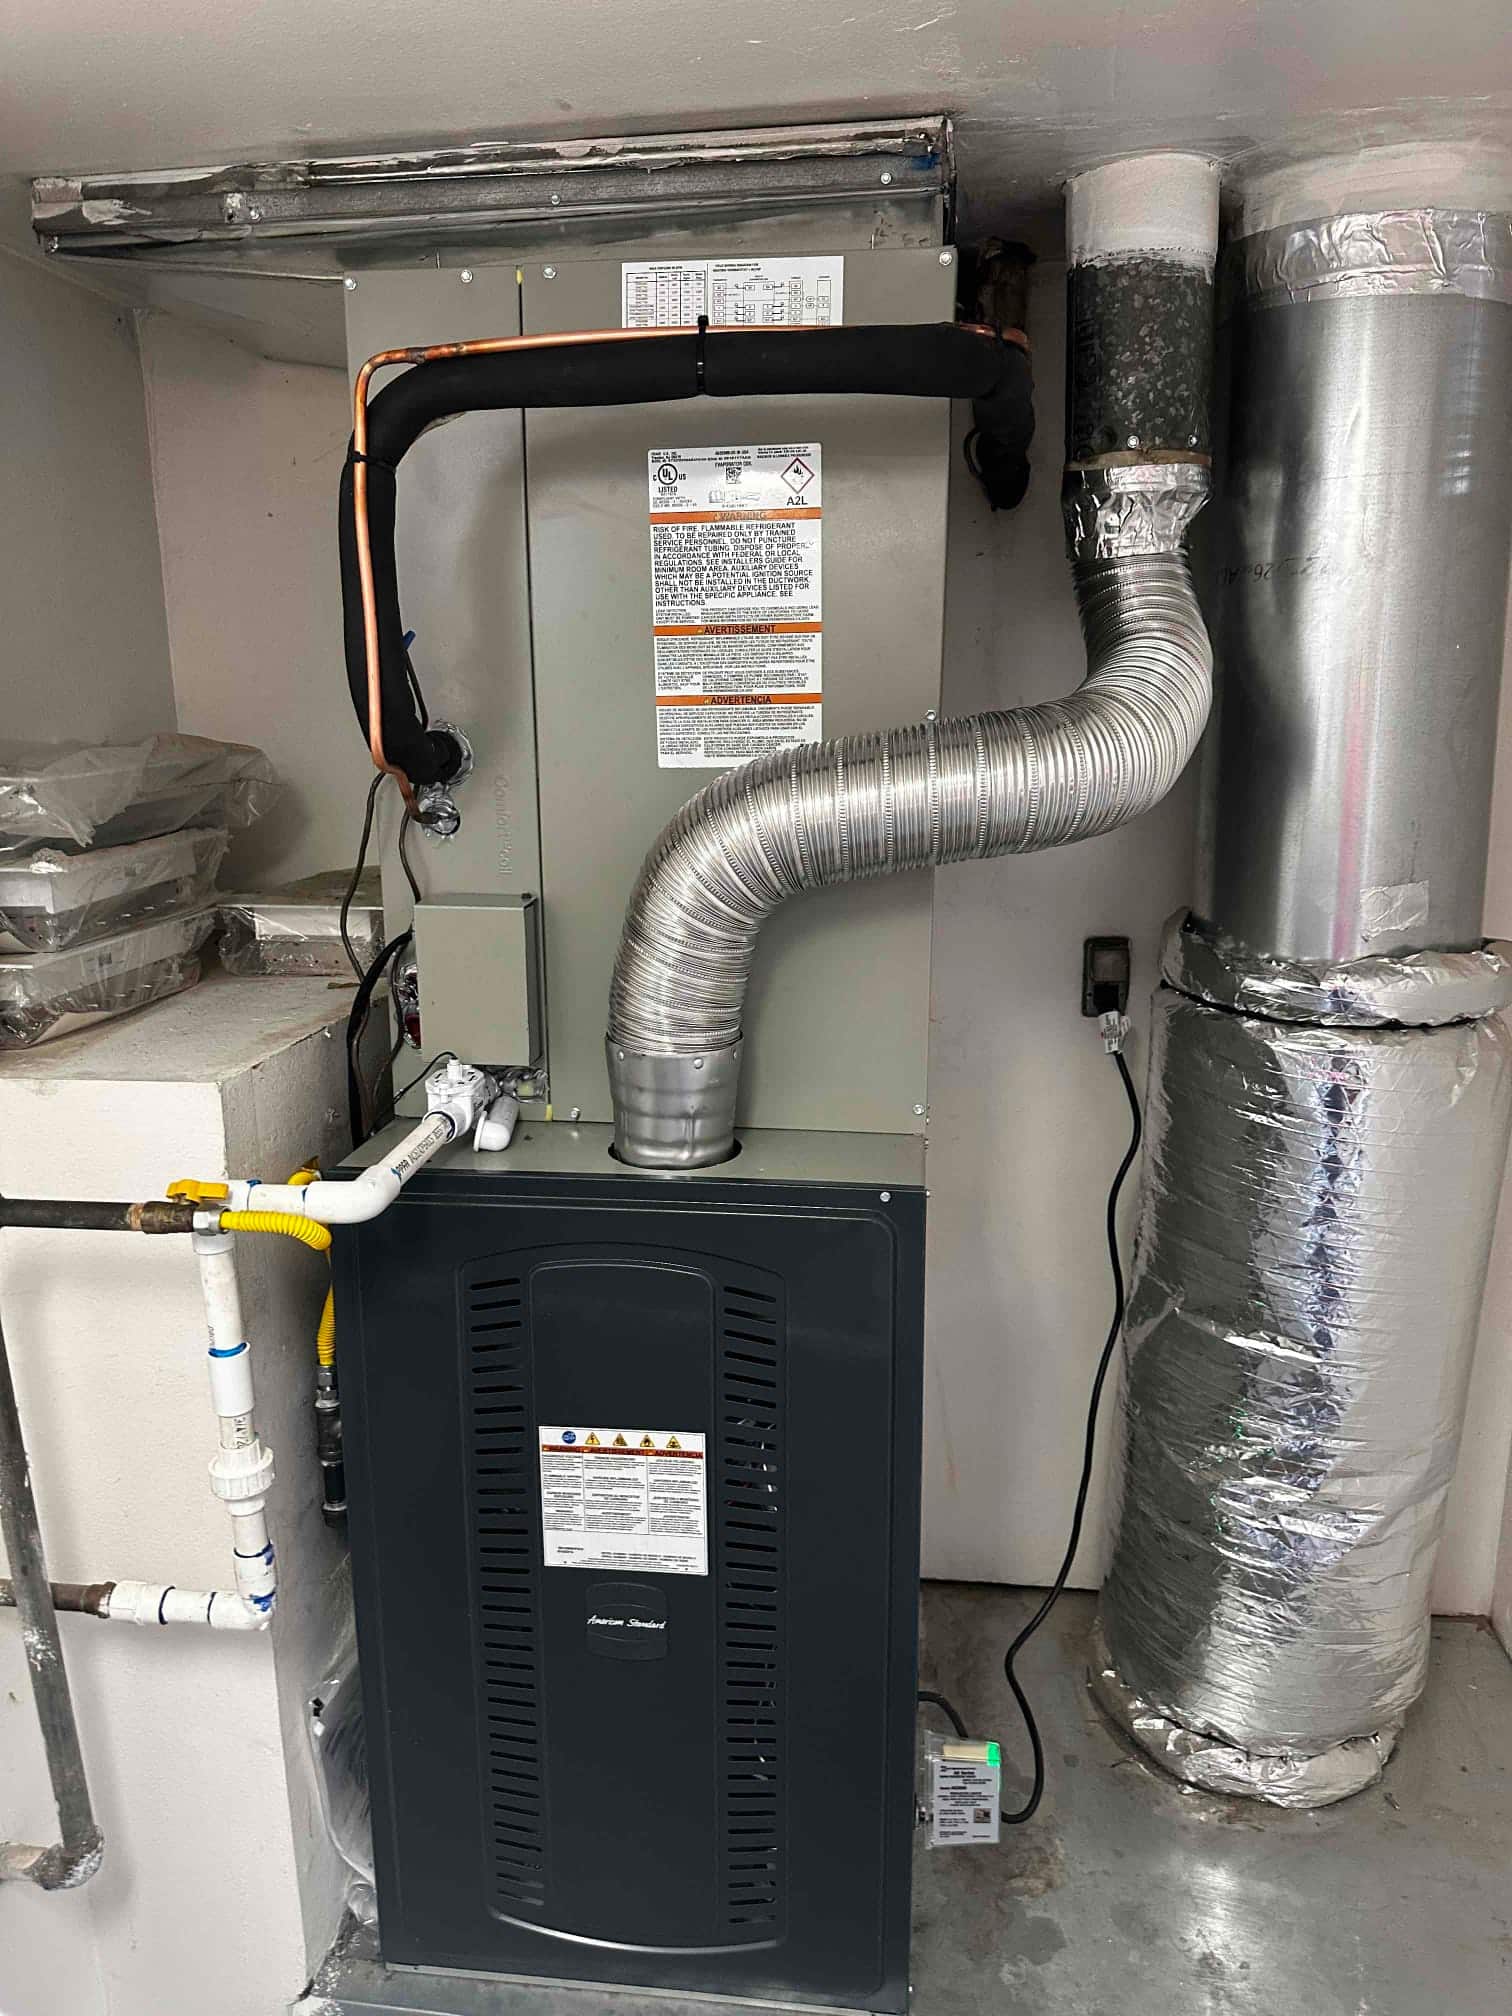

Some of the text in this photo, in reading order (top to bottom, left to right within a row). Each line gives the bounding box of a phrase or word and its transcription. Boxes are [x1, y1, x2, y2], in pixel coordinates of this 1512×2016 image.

[786, 495, 808, 506] A2L
[704, 624, 776, 635] AVERTISSEMENT
[710, 696, 772, 705] ADVERTENCIA
[626, 1618, 667, 1629] Standard
